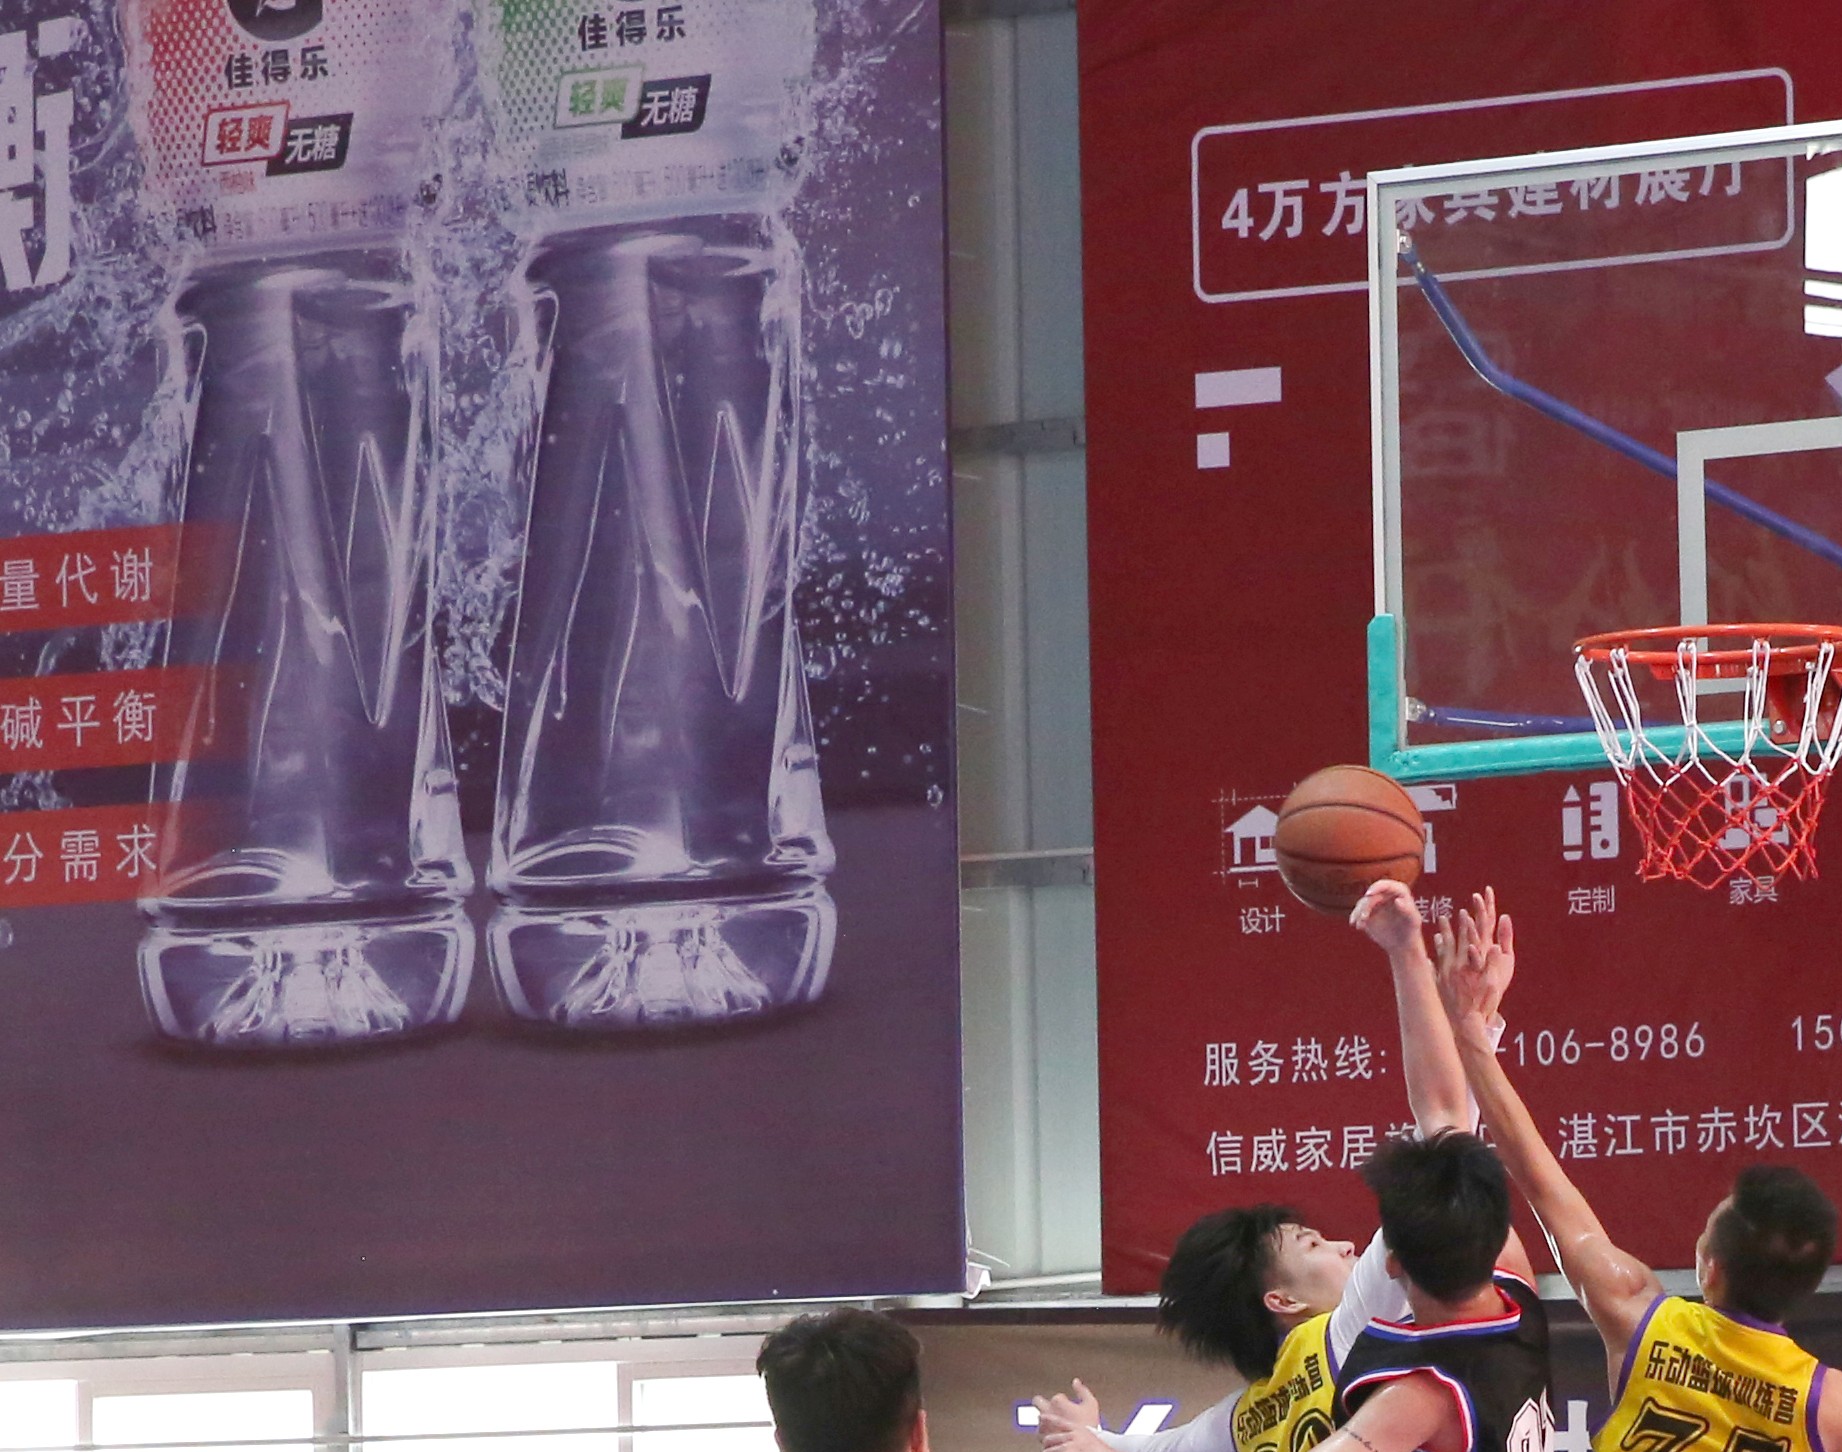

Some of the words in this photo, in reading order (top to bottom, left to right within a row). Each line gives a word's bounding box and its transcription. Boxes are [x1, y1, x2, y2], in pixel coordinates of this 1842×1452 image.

[577, 5, 686, 51] 佳得乐
[225, 44, 328, 90] 佳得乐
[640, 86, 698, 127] 无糖
[216, 115, 274, 154] 轻爽
[284, 124, 341, 164] 无糖
[0, 548, 153, 610] 量代谢
[0, 688, 158, 750] 碱平衡
[3, 824, 158, 883] 分需求
[1568, 887, 1616, 915] 定制
[1729, 875, 1778, 905] 家具
[1239, 907, 1286, 935] 设计
[1495, 1021, 1706, 1067] -106-8986
